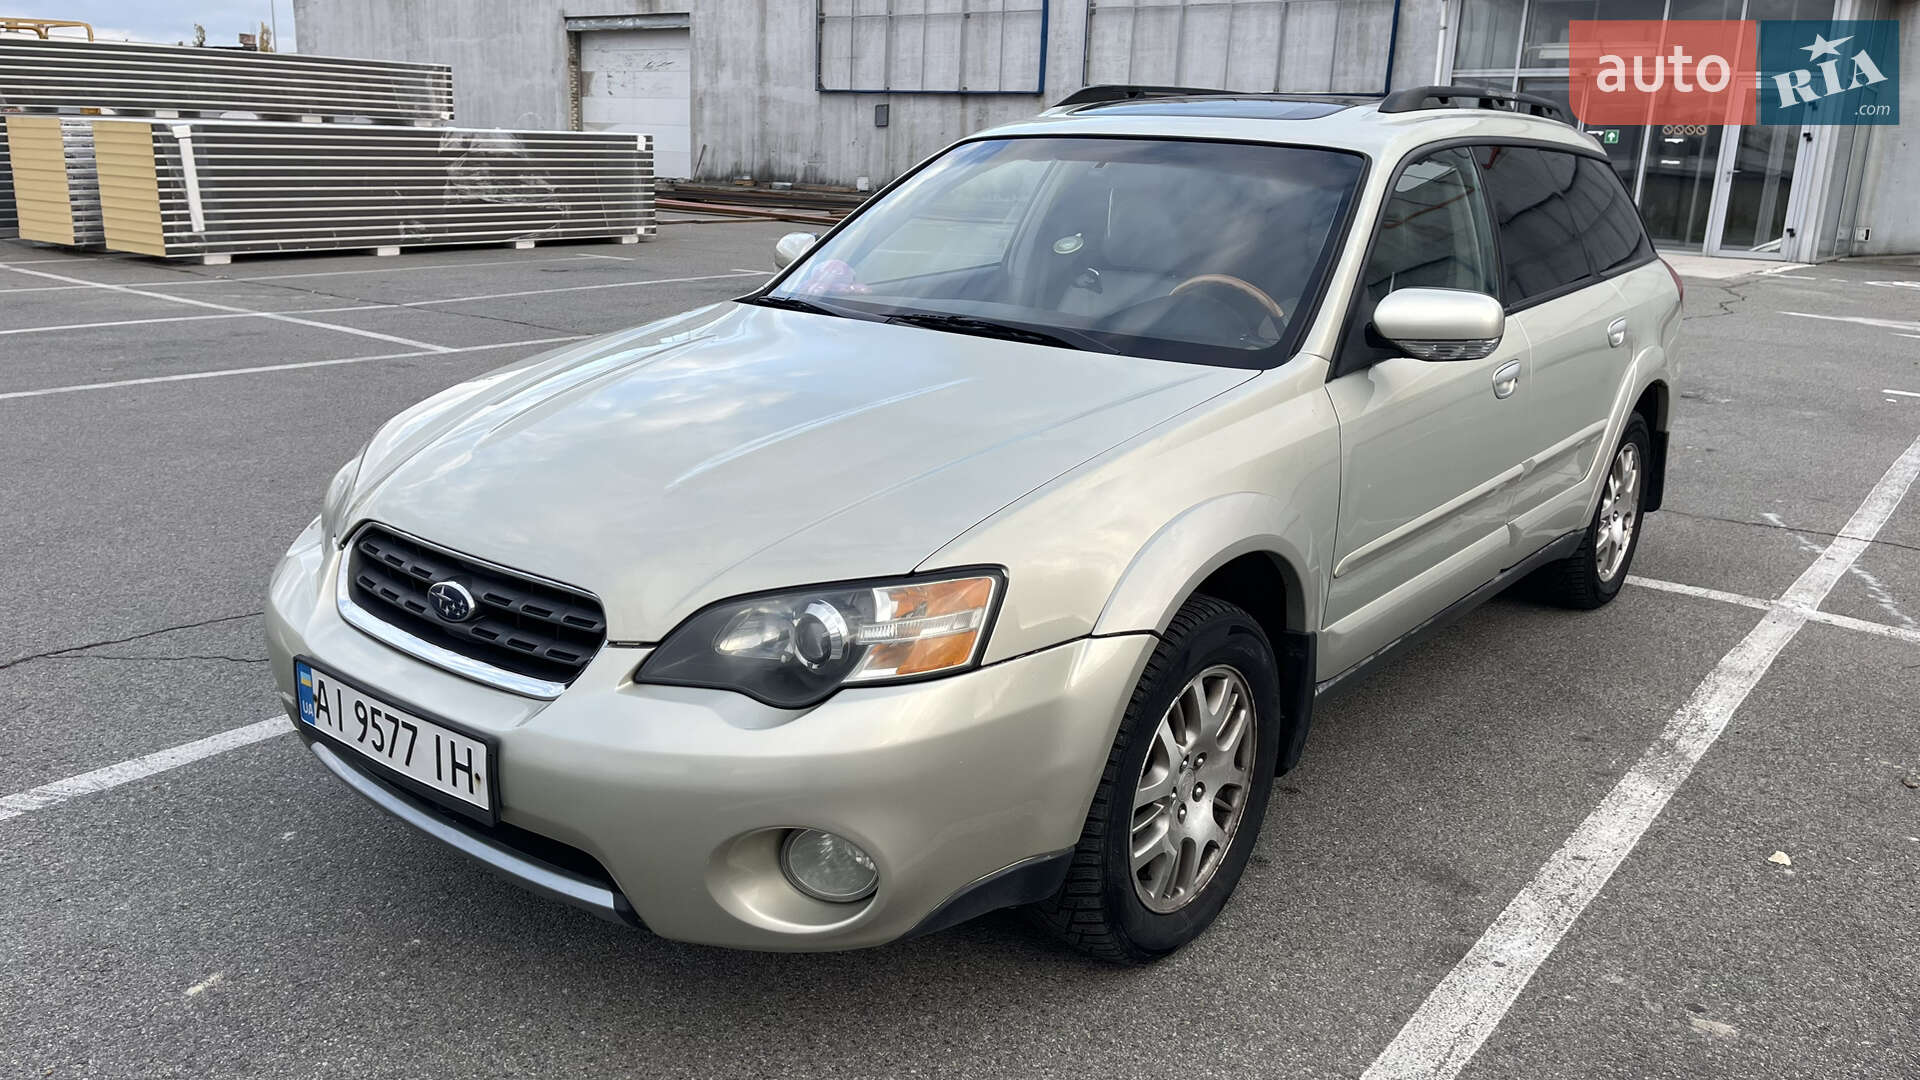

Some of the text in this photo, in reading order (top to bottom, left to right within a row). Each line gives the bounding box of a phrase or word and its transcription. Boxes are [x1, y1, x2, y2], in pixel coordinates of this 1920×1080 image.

[302, 700, 314, 717] UA
[316, 679, 474, 795] AI 9577 IH
